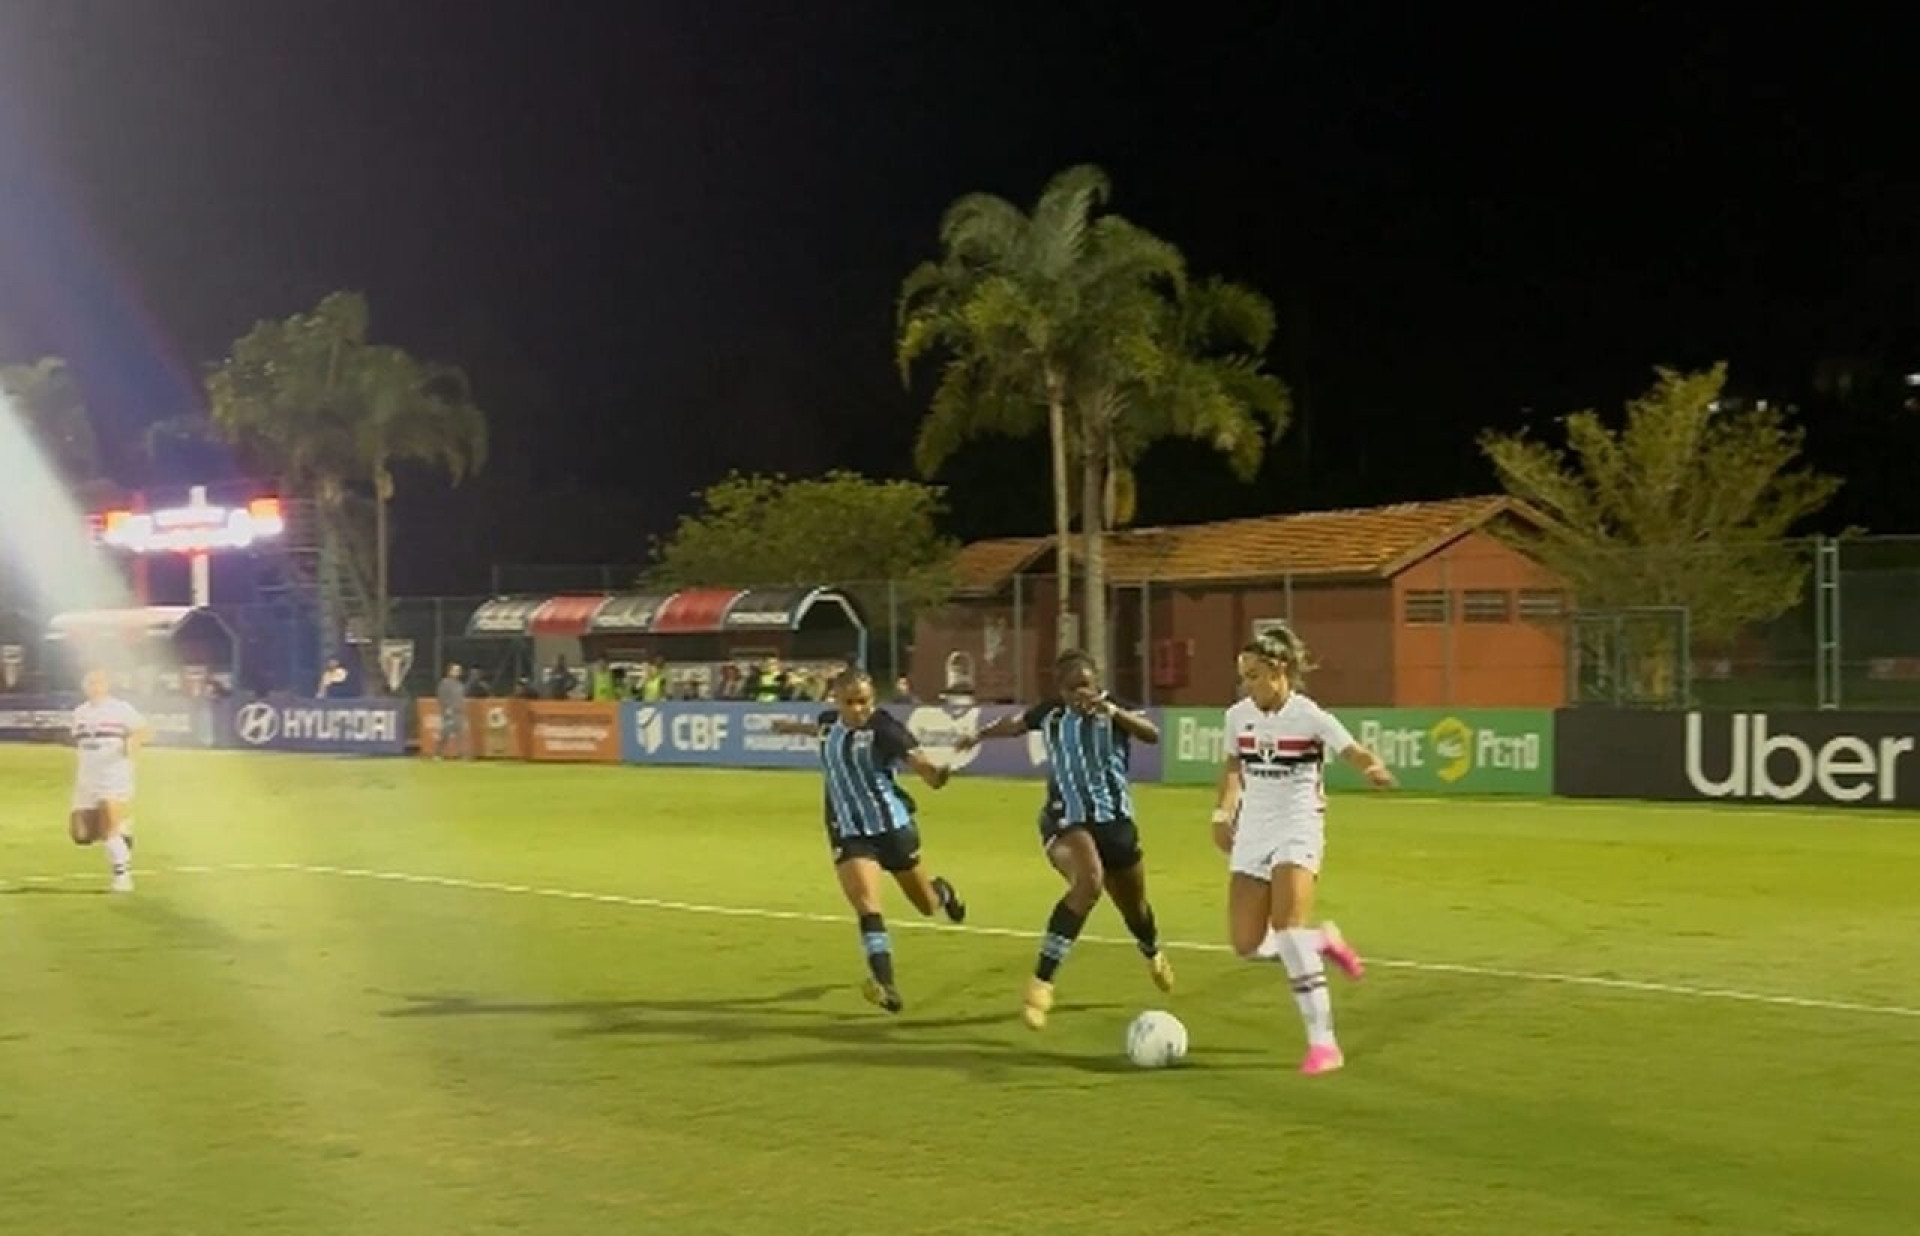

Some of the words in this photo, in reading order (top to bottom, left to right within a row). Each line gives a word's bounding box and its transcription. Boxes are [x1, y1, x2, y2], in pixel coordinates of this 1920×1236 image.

[283, 709, 397, 742] HYUNDAI
[672, 715, 729, 751] CBF
[1686, 712, 1915, 801] Uber
